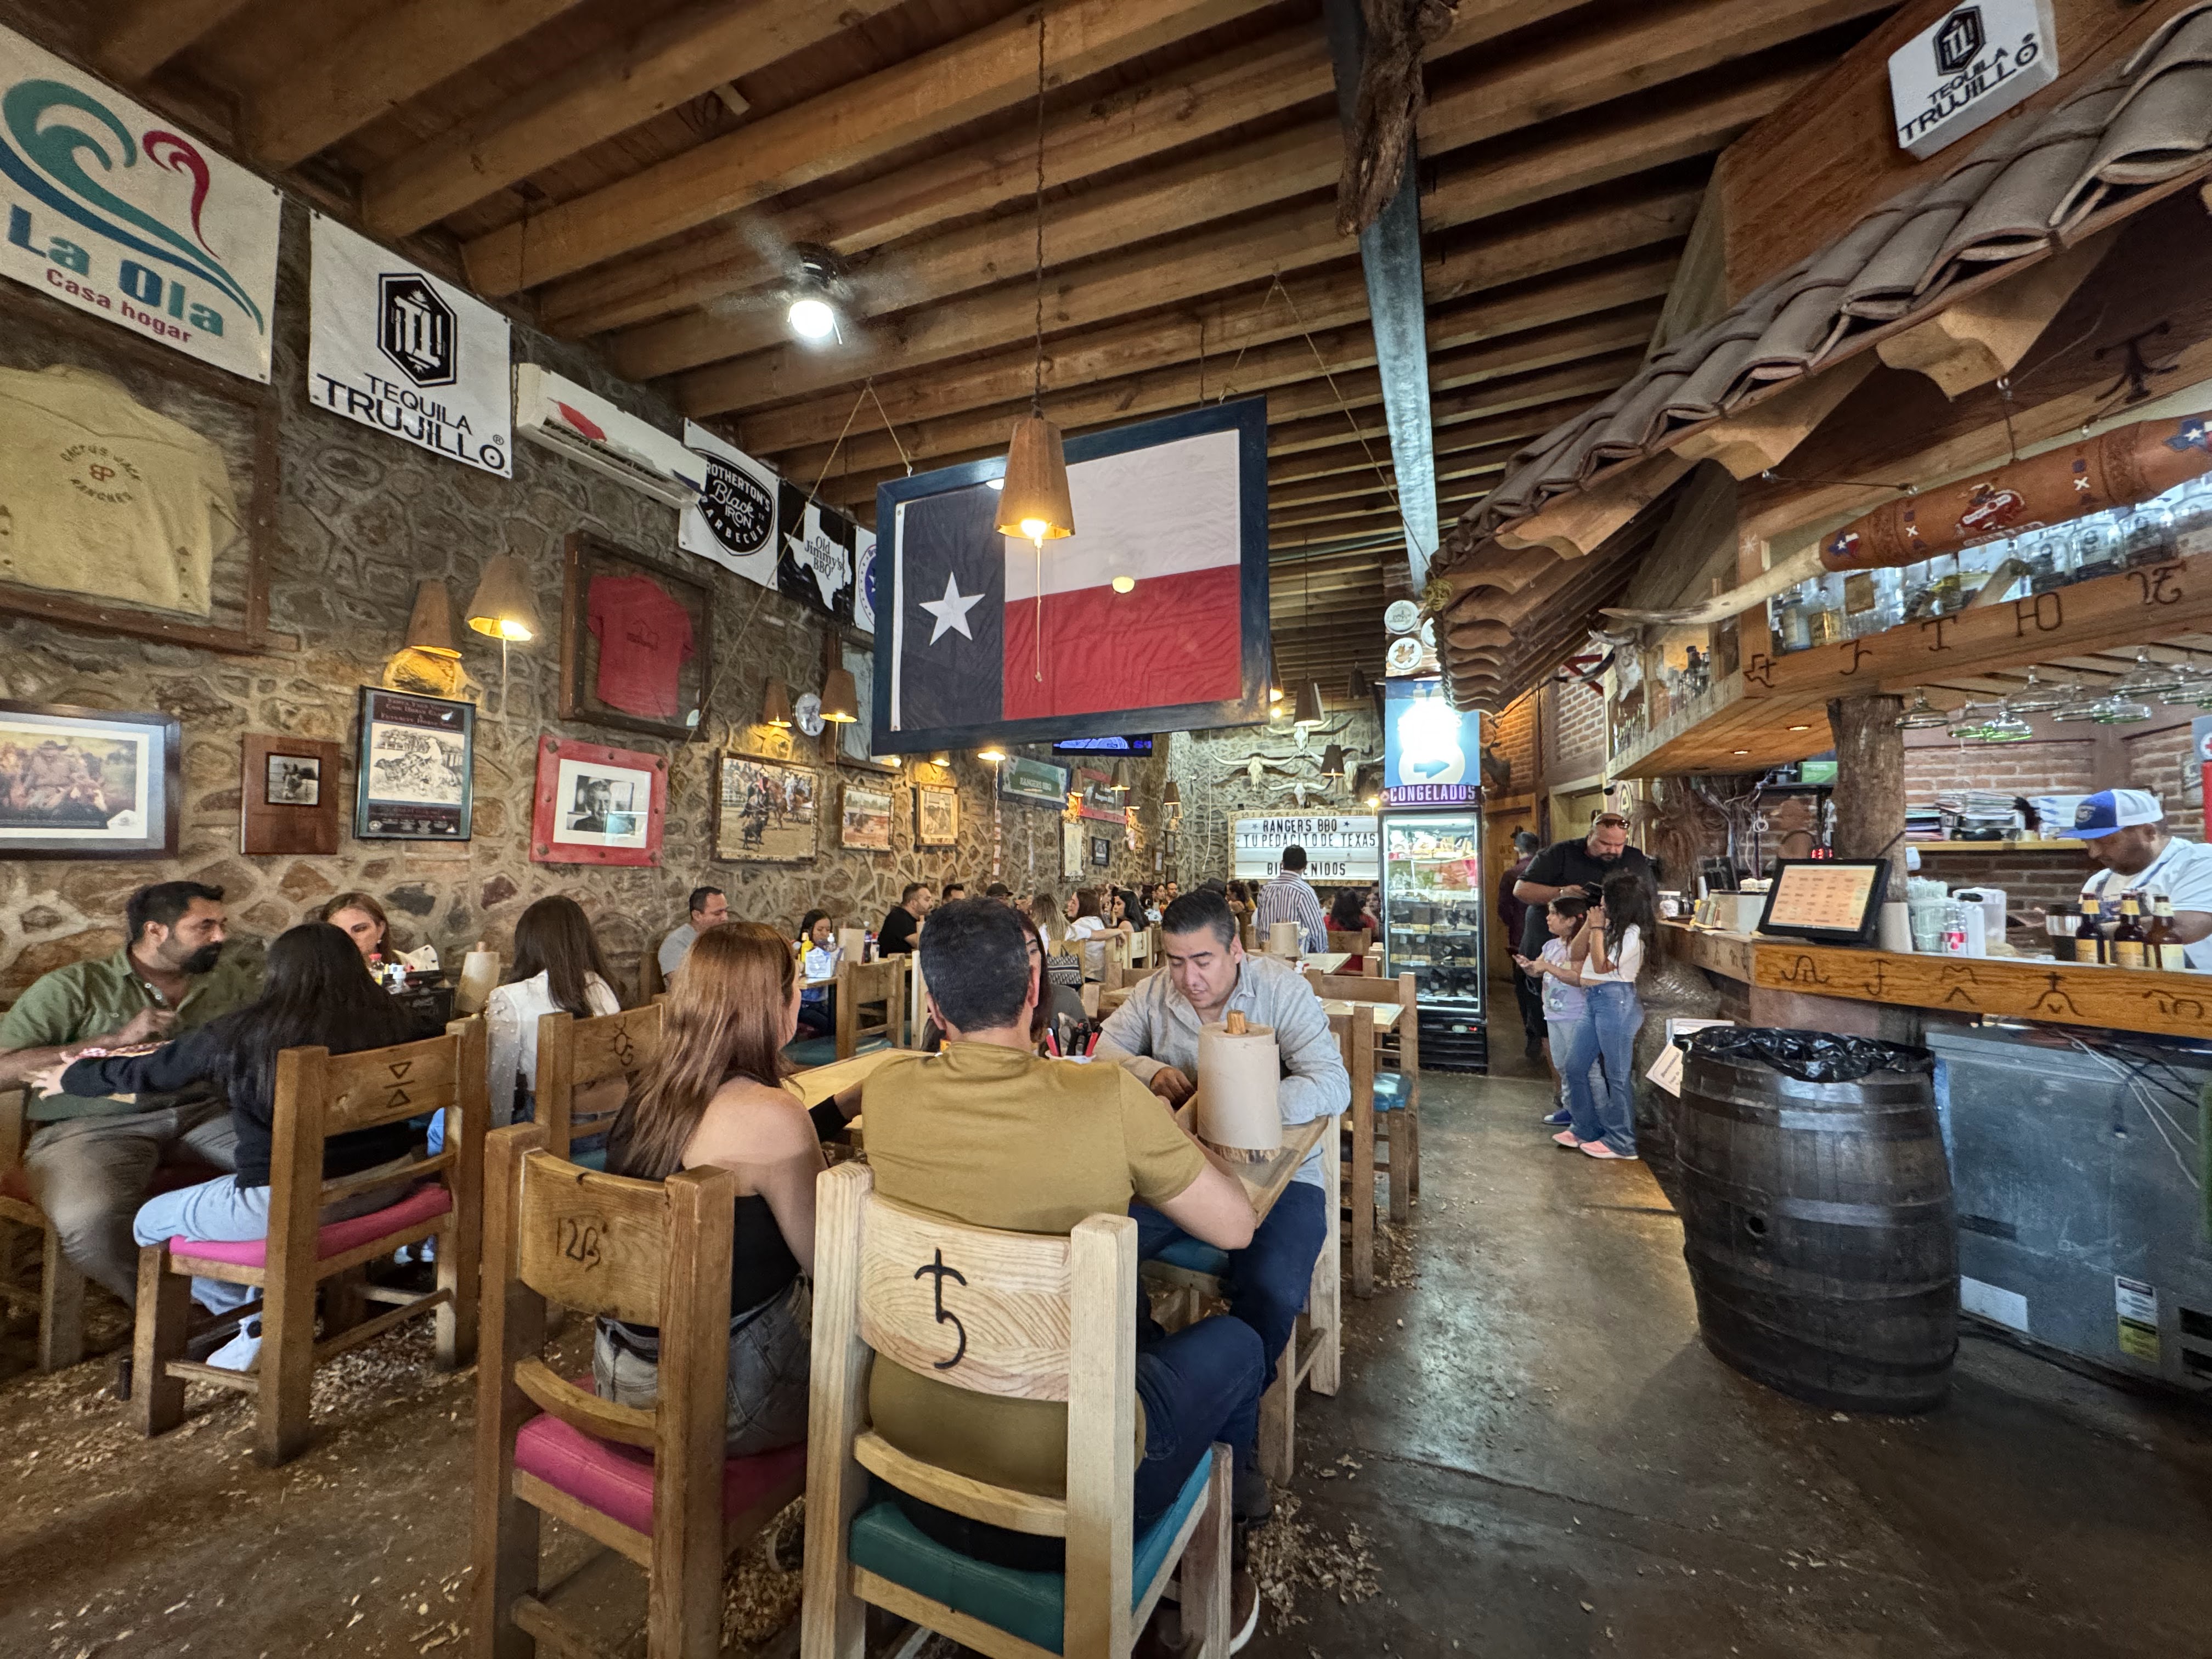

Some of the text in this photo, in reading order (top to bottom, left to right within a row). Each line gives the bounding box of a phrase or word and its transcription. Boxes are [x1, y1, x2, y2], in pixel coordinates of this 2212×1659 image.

[1899, 42, 2038, 140] TRUJILLO
[1927, 47, 2008, 105] TEQUILA
[8, 204, 223, 337] La Ola
[47, 268, 193, 343] Casa hogar
[317, 373, 505, 470] TRUJILLO
[364, 372, 473, 436] TEQUILA
[60, 444, 109, 461] CACTUS
[707, 461, 771, 512] ROTHERTON'S
[709, 479, 755, 518] Black
[701, 495, 764, 544] BARBECUE
[725, 505, 752, 529] IRON
[804, 540, 843, 573] Jimmy's
[816, 536, 830, 554] Old
[814, 557, 831, 580] BBQ
[1390, 785, 1476, 802] CONGELADOS
[1244, 834, 1257, 847] TU
[1321, 833, 1334, 847] DE
[1341, 833, 1376, 847] TEXAS
[1263, 819, 1312, 833] RANGER'S
[1267, 862, 1345, 876] BIENIDOS
